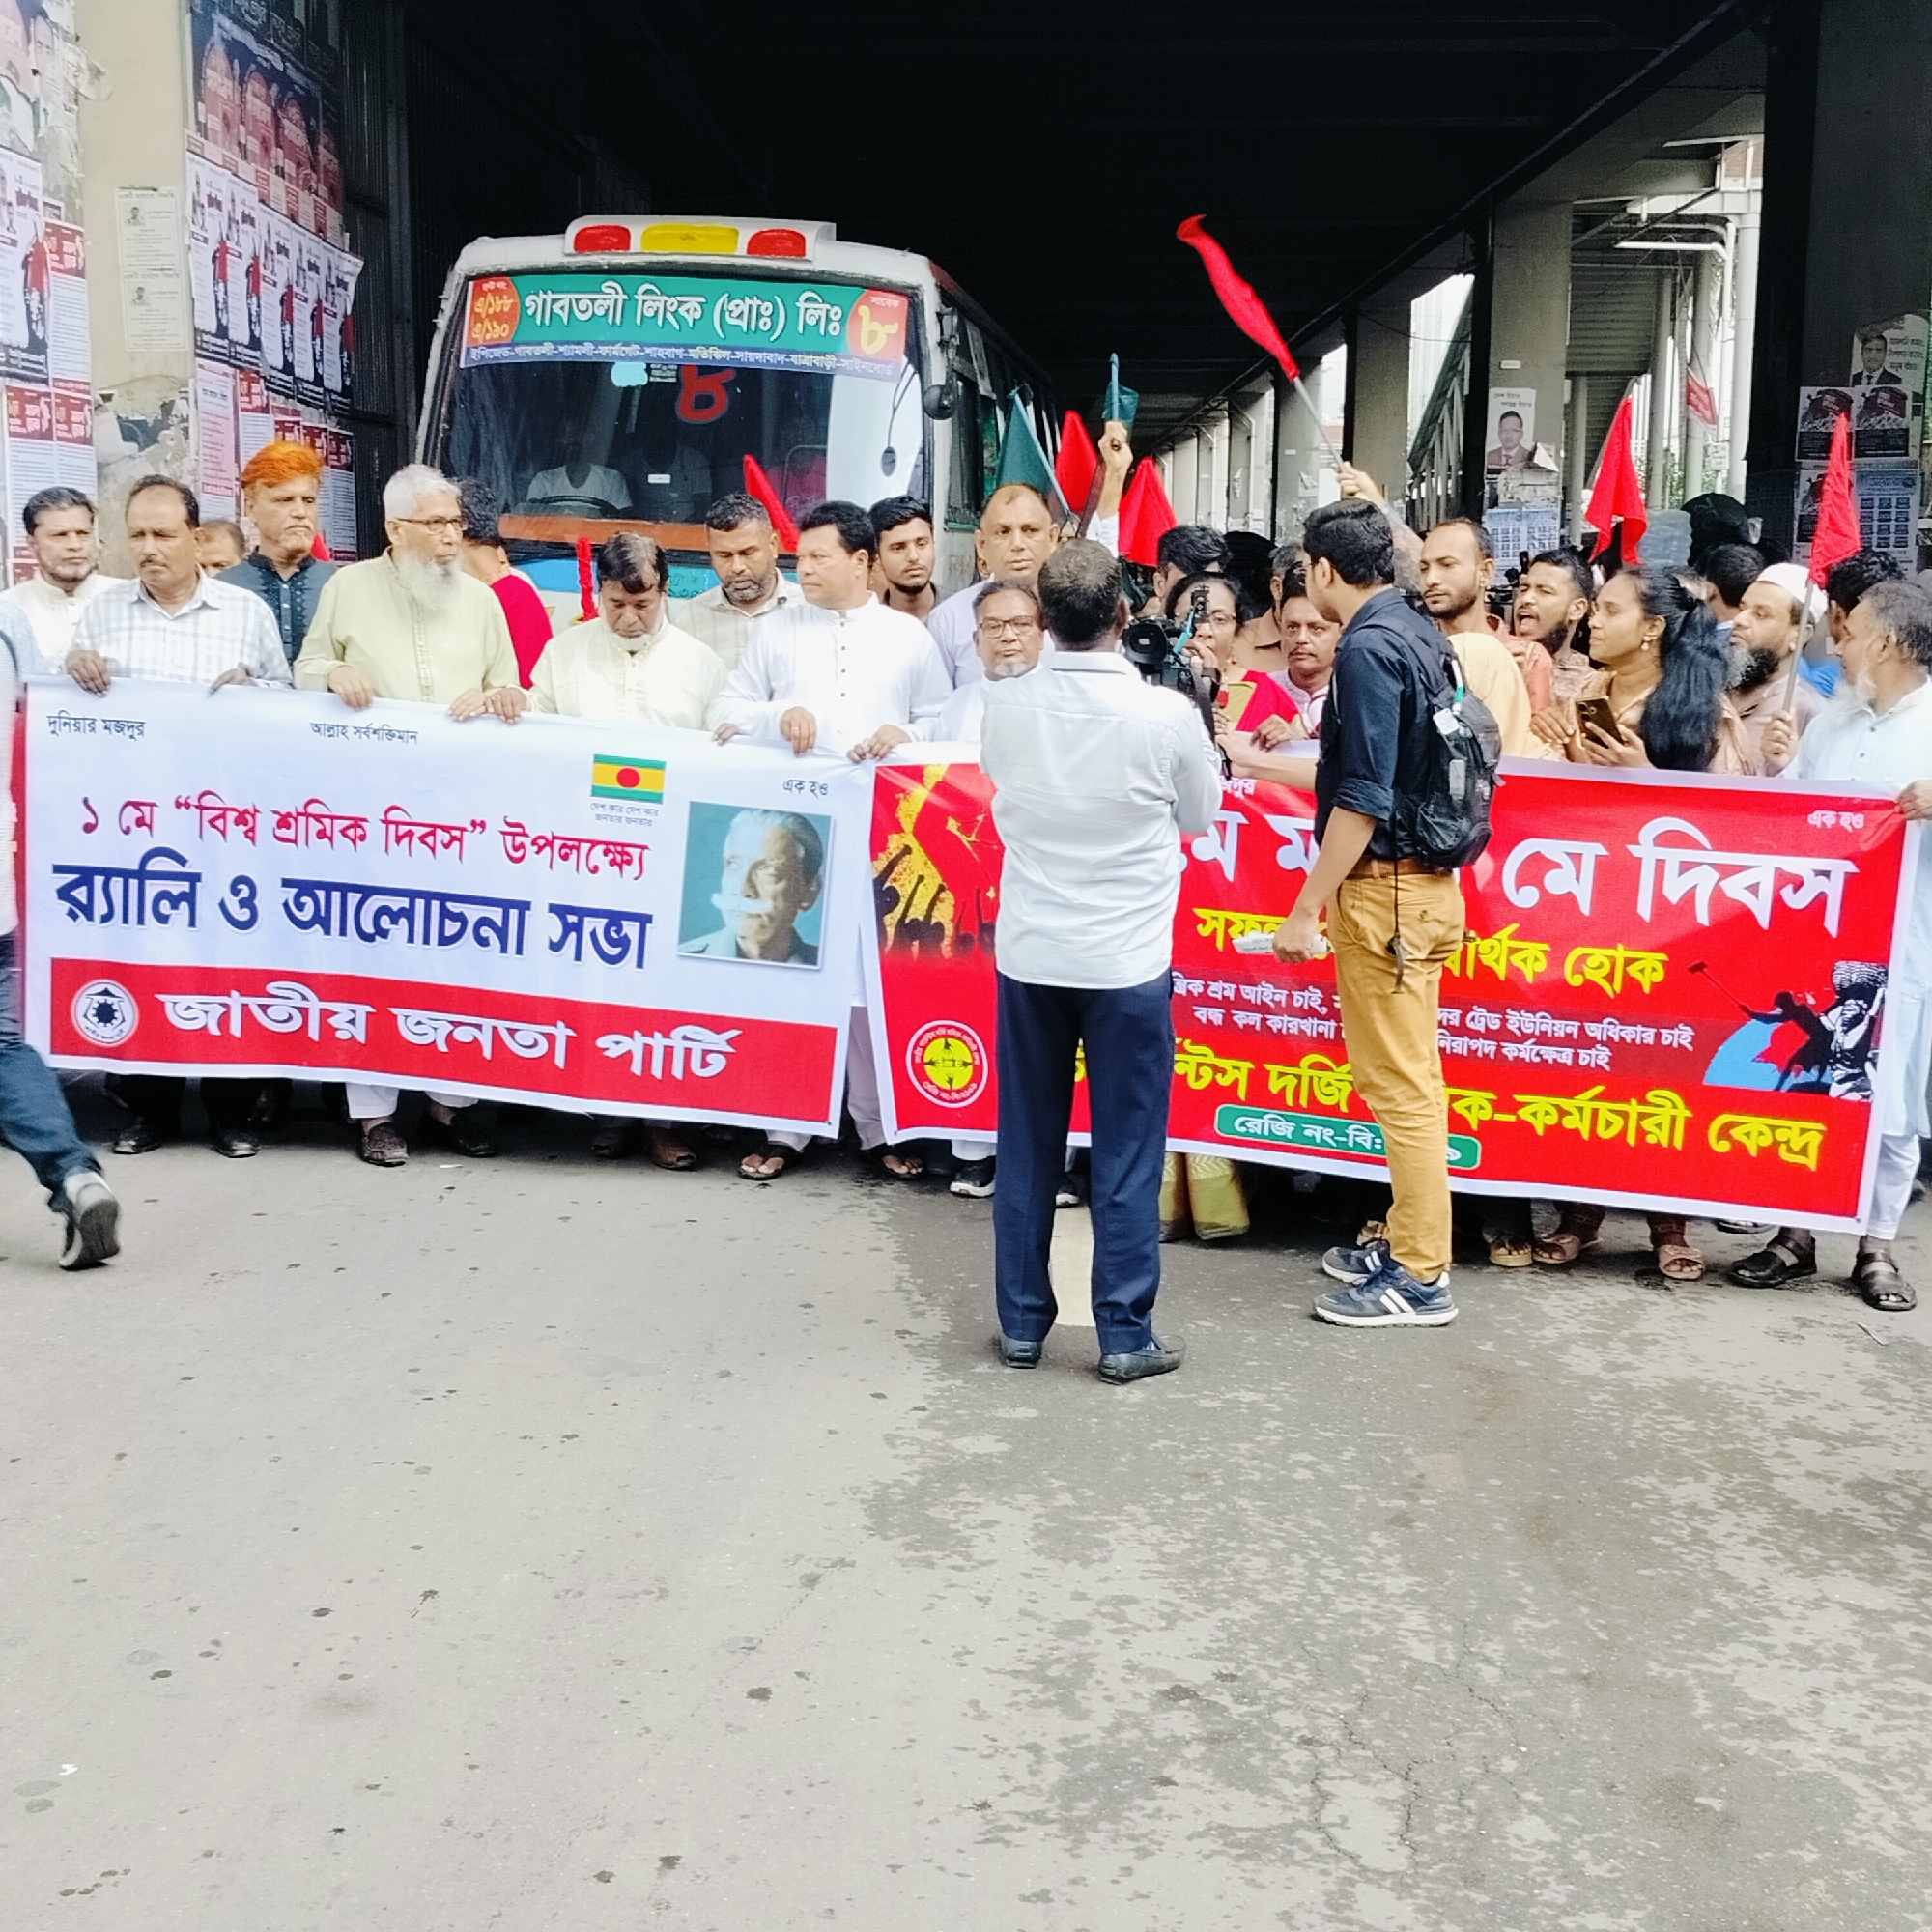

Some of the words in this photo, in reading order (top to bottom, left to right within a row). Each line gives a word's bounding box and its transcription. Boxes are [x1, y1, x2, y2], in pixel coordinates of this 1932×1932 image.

[525, 280, 629, 327] গাবতলী
[634, 282, 706, 331] লিংক
[713, 293, 785, 341] (প্রাঃ)
[795, 290, 842, 336] লিঃ
[858, 305, 899, 355] ৮
[46, 709, 98, 737] দুনিয়ার
[99, 718, 146, 741] মজদুর
[309, 722, 350, 741] আল্লাহ
[351, 722, 418, 745] সর্বশক্তিমান
[782, 779, 805, 795] এক
[809, 780, 829, 798] হও
[82, 797, 99, 834] ১
[119, 800, 158, 838] মে
[271, 798, 369, 850] শ্রমিক
[497, 815, 652, 881] উপলক্ষ্যে
[1807, 810, 1837, 828] এক
[1837, 811, 1864, 833] হও
[1501, 837, 1610, 917] মে
[1628, 816, 1859, 939] দিবস
[218, 874, 259, 930] ও
[280, 877, 531, 956] আলোচনা
[548, 902, 654, 970] সভা
[1564, 942, 1668, 998] হোক
[1207, 980, 1237, 1001] শ্রম
[1239, 980, 1289, 1008] আইন
[154, 980, 376, 1044] জাতীয়
[387, 1007, 577, 1070] জনতা
[595, 1024, 743, 1080] পার্টি
[1193, 1005, 1226, 1026] বন্ধ
[1231, 1009, 1264, 1031] কল
[1265, 1014, 1337, 1040] কারখানা
[1505, 1008, 1582, 1039] ইউনিয়ন
[1584, 1016, 1657, 1045] অধিকার
[1660, 1023, 1695, 1051] চাই
[1577, 1043, 1612, 1071] চাই
[1234, 1113, 1296, 1140] রেজি
[1708, 1111, 1827, 1172] কেন্দ্র
